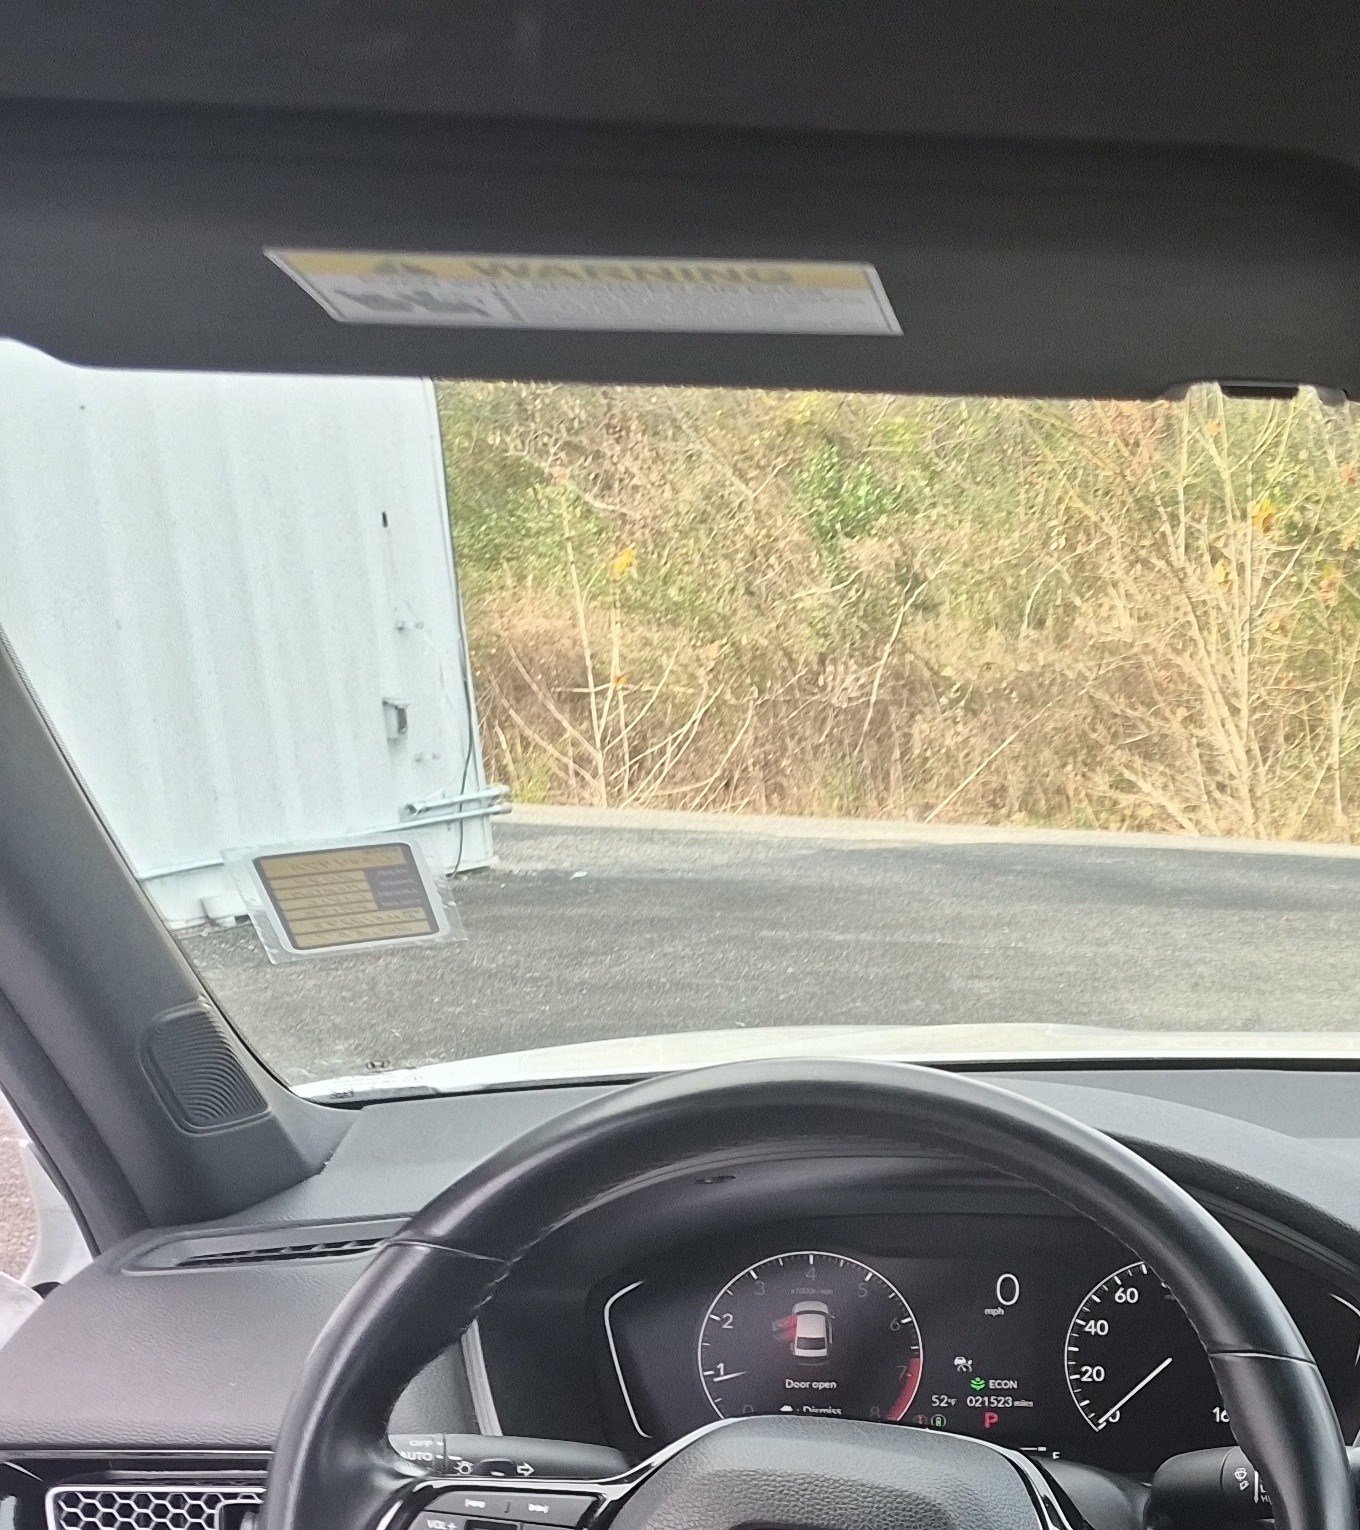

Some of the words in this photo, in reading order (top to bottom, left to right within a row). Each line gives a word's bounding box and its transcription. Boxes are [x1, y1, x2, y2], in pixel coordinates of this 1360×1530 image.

[465, 261, 793, 284] WARNING
[804, 1267, 816, 1281] 4
[754, 1281, 766, 1296] 3
[857, 1283, 869, 1298] 5
[996, 1273, 1020, 1306] 0
[1114, 1287, 1139, 1304] 60
[984, 1307, 1004, 1317] mph
[722, 1313, 734, 1329] 2
[889, 1317, 901, 1332] 6
[1084, 1319, 1109, 1336] 40
[716, 1362, 725, 1376] 1
[1080, 1366, 1105, 1382] 20
[785, 1379, 811, 1390] Door
[812, 1380, 837, 1392] open
[988, 1379, 1018, 1389] ECON
[966, 1396, 1013, 1407] 021523
[984, 1412, 999, 1428] P
